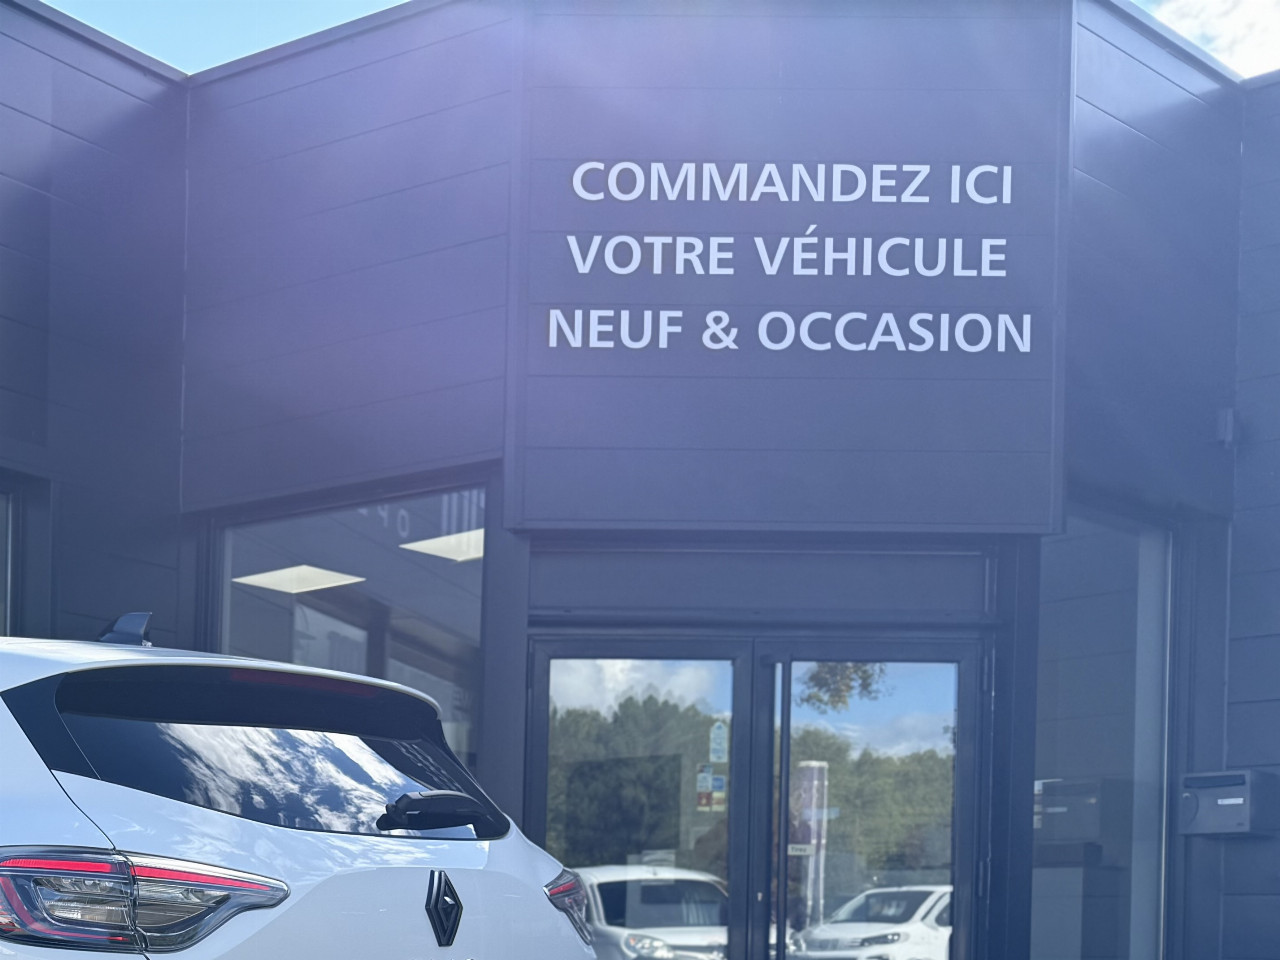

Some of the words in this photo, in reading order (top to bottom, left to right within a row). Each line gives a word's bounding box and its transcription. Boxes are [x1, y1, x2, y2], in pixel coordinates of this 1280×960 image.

[571, 161, 932, 204] COMMANDEZ
[949, 164, 1014, 204] ICI
[566, 234, 736, 276] VOTRE
[753, 224, 1009, 278] VÉHICULE
[547, 309, 684, 350] NEUF
[700, 310, 740, 351] &
[756, 310, 1033, 354] OCCASION
